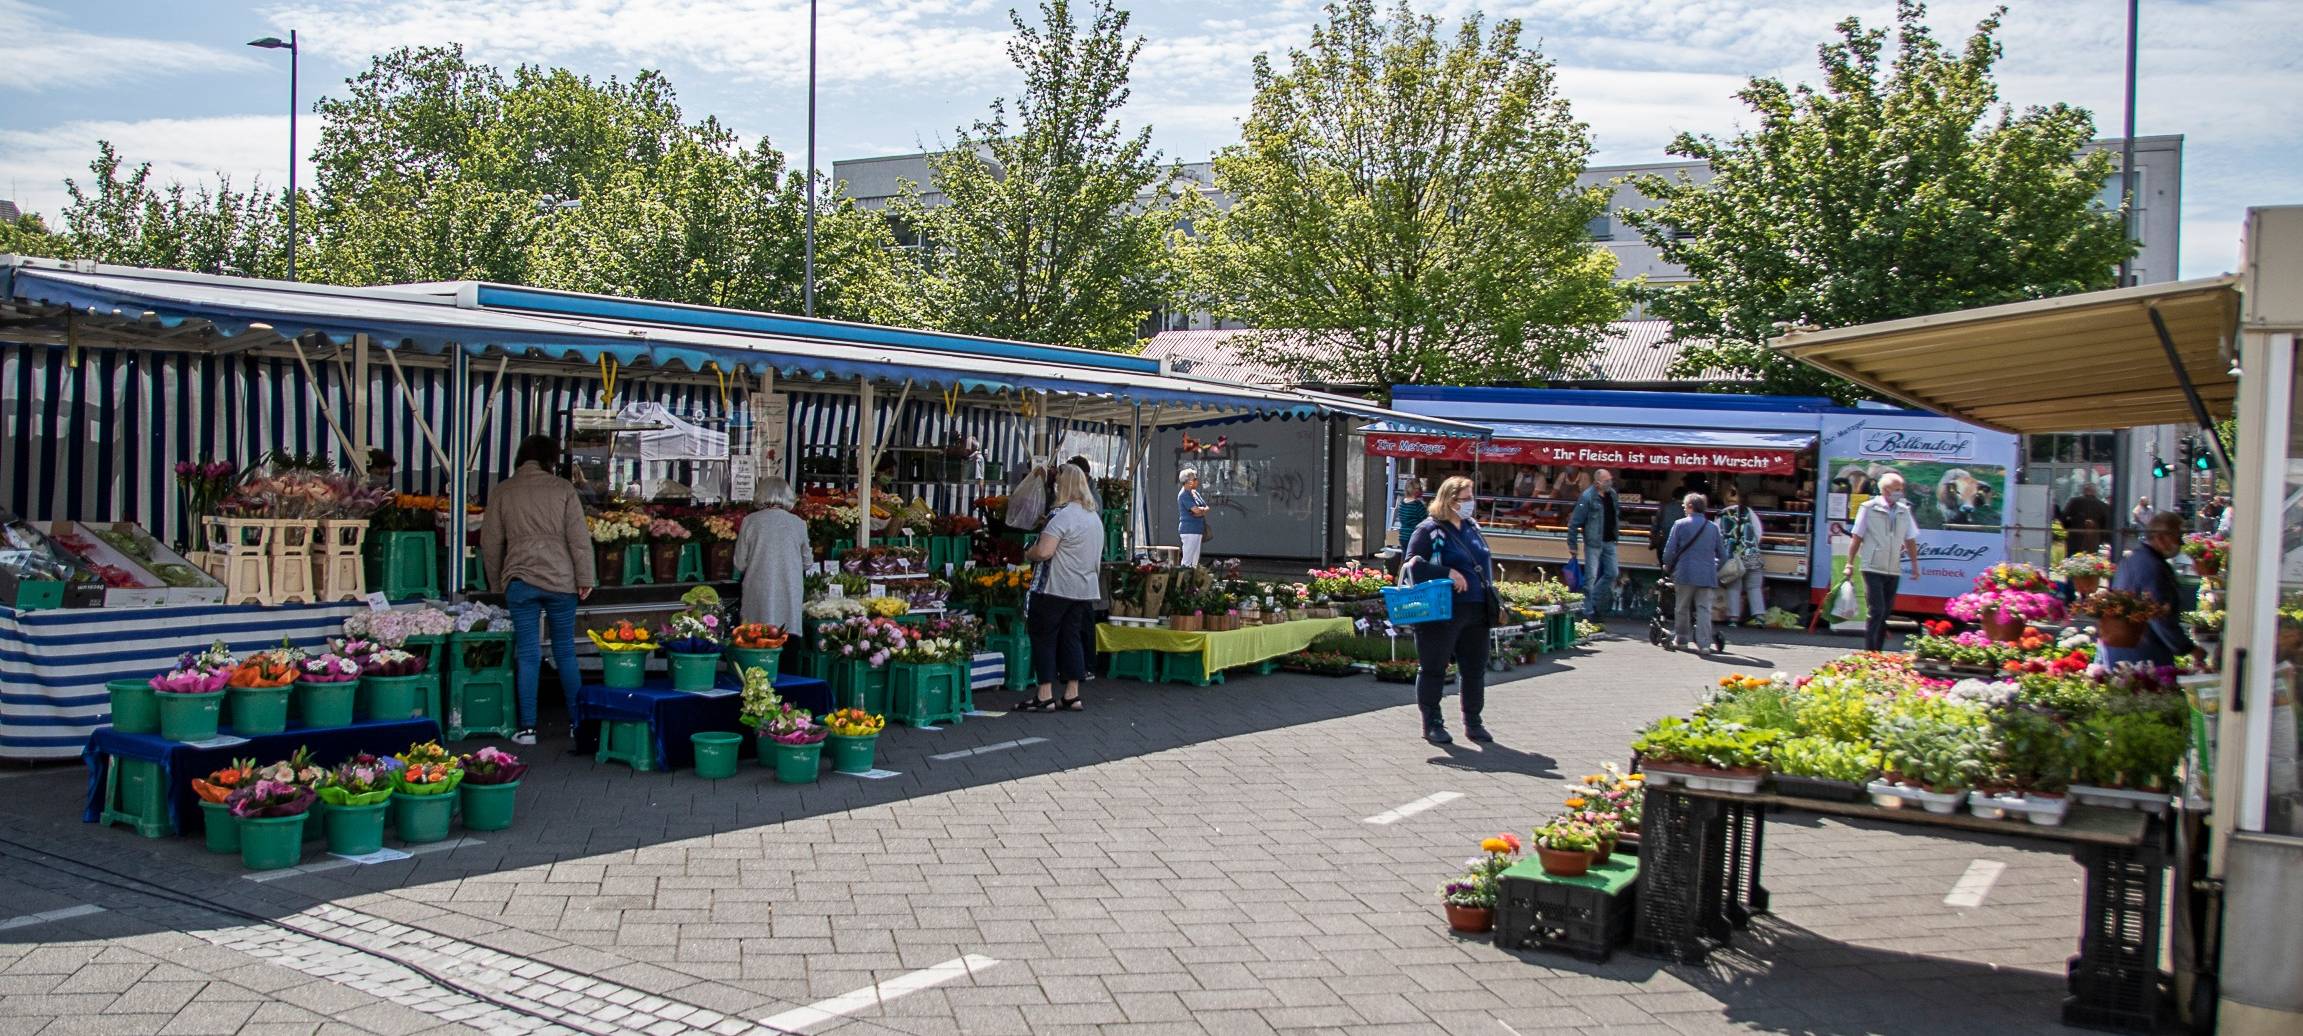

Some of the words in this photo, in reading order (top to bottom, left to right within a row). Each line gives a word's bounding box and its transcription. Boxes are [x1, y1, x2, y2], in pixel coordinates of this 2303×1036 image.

[1375, 438, 1396, 450] Ihr
[1399, 439, 1446, 455] Metzger
[1552, 448, 1575, 460] Ihr
[1579, 449, 1623, 463] Fleisch
[1628, 451, 1645, 463] ist
[1650, 454, 1670, 465] uns
[1675, 453, 1708, 466] nicht
[1712, 454, 1769, 468] Wurscht
[1921, 567, 1965, 577] Lembeck
